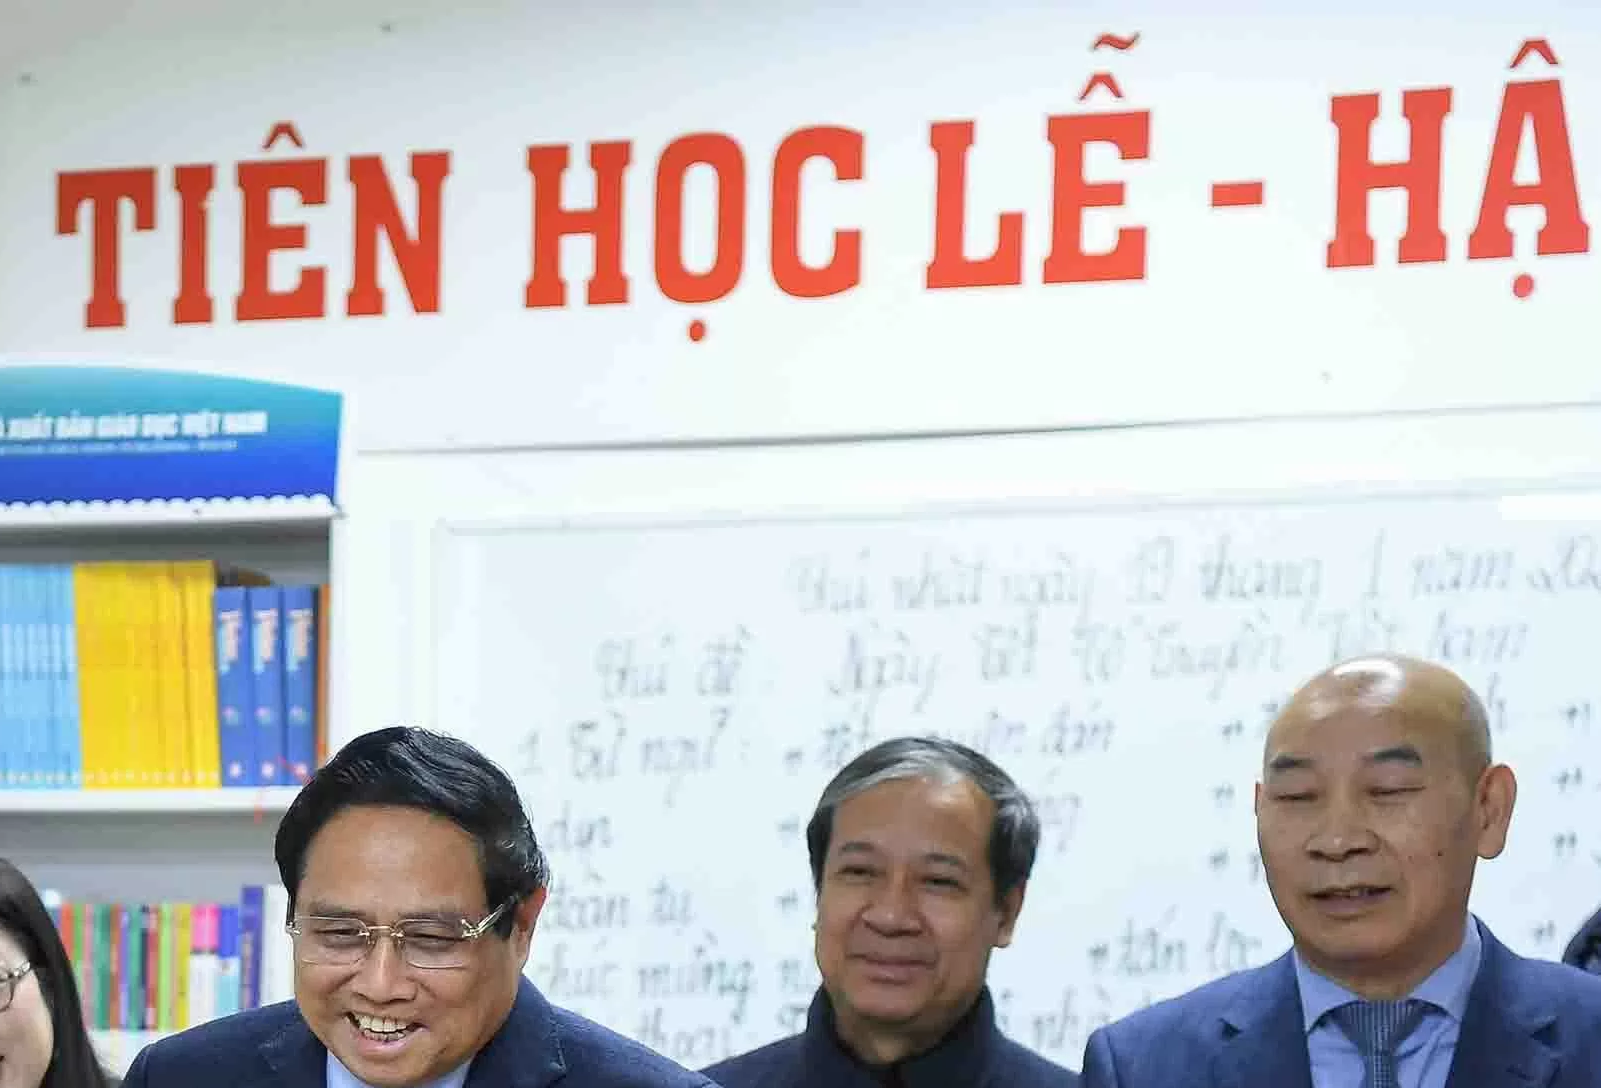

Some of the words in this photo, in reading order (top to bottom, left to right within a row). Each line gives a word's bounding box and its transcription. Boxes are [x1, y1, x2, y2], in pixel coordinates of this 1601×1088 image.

[58, 122, 450, 328] TIÊN
[526, 127, 863, 341] HỌC
[926, 36, 1150, 289] LỄ
